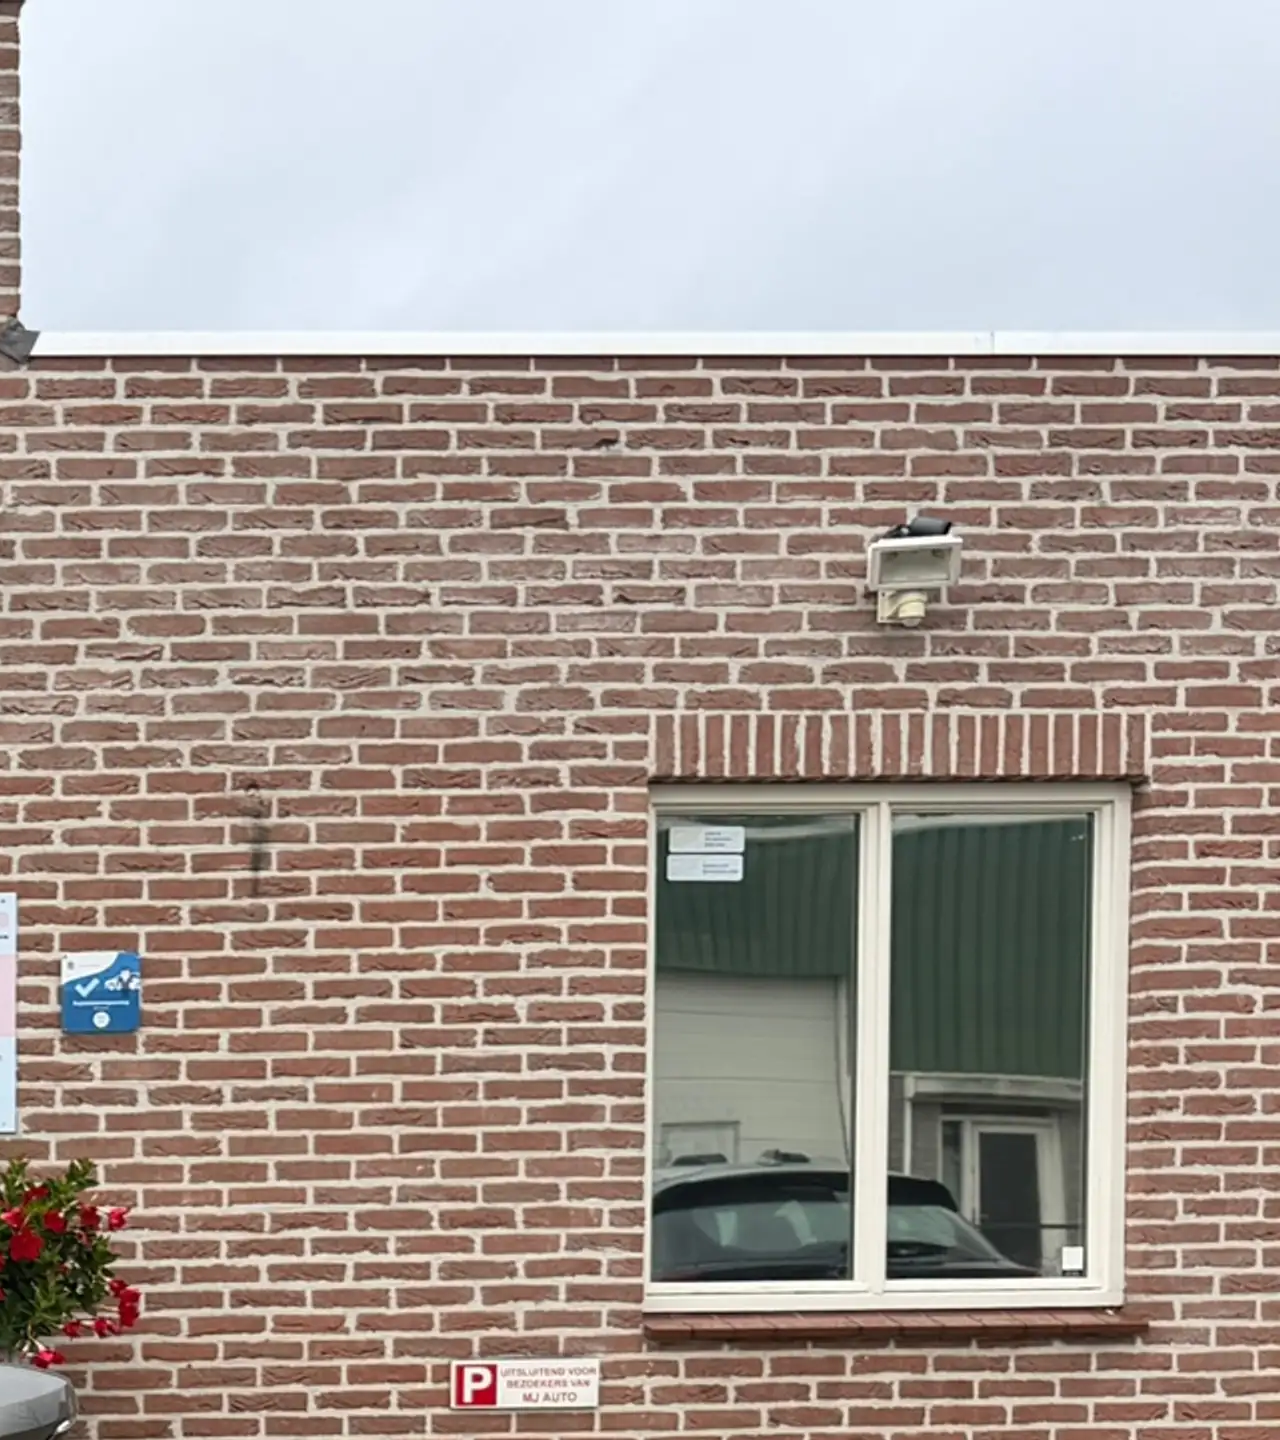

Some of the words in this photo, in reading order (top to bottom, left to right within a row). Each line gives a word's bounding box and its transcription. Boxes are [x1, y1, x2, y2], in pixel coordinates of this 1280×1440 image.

[500, 1367, 566, 1378] UITSLUITEND
[567, 1366, 597, 1376] VOOR
[461, 1366, 493, 1404] P
[506, 1378, 568, 1389] BEZOEKERS
[522, 1391, 539, 1403] MJ
[542, 1390, 577, 1402] AUTO
